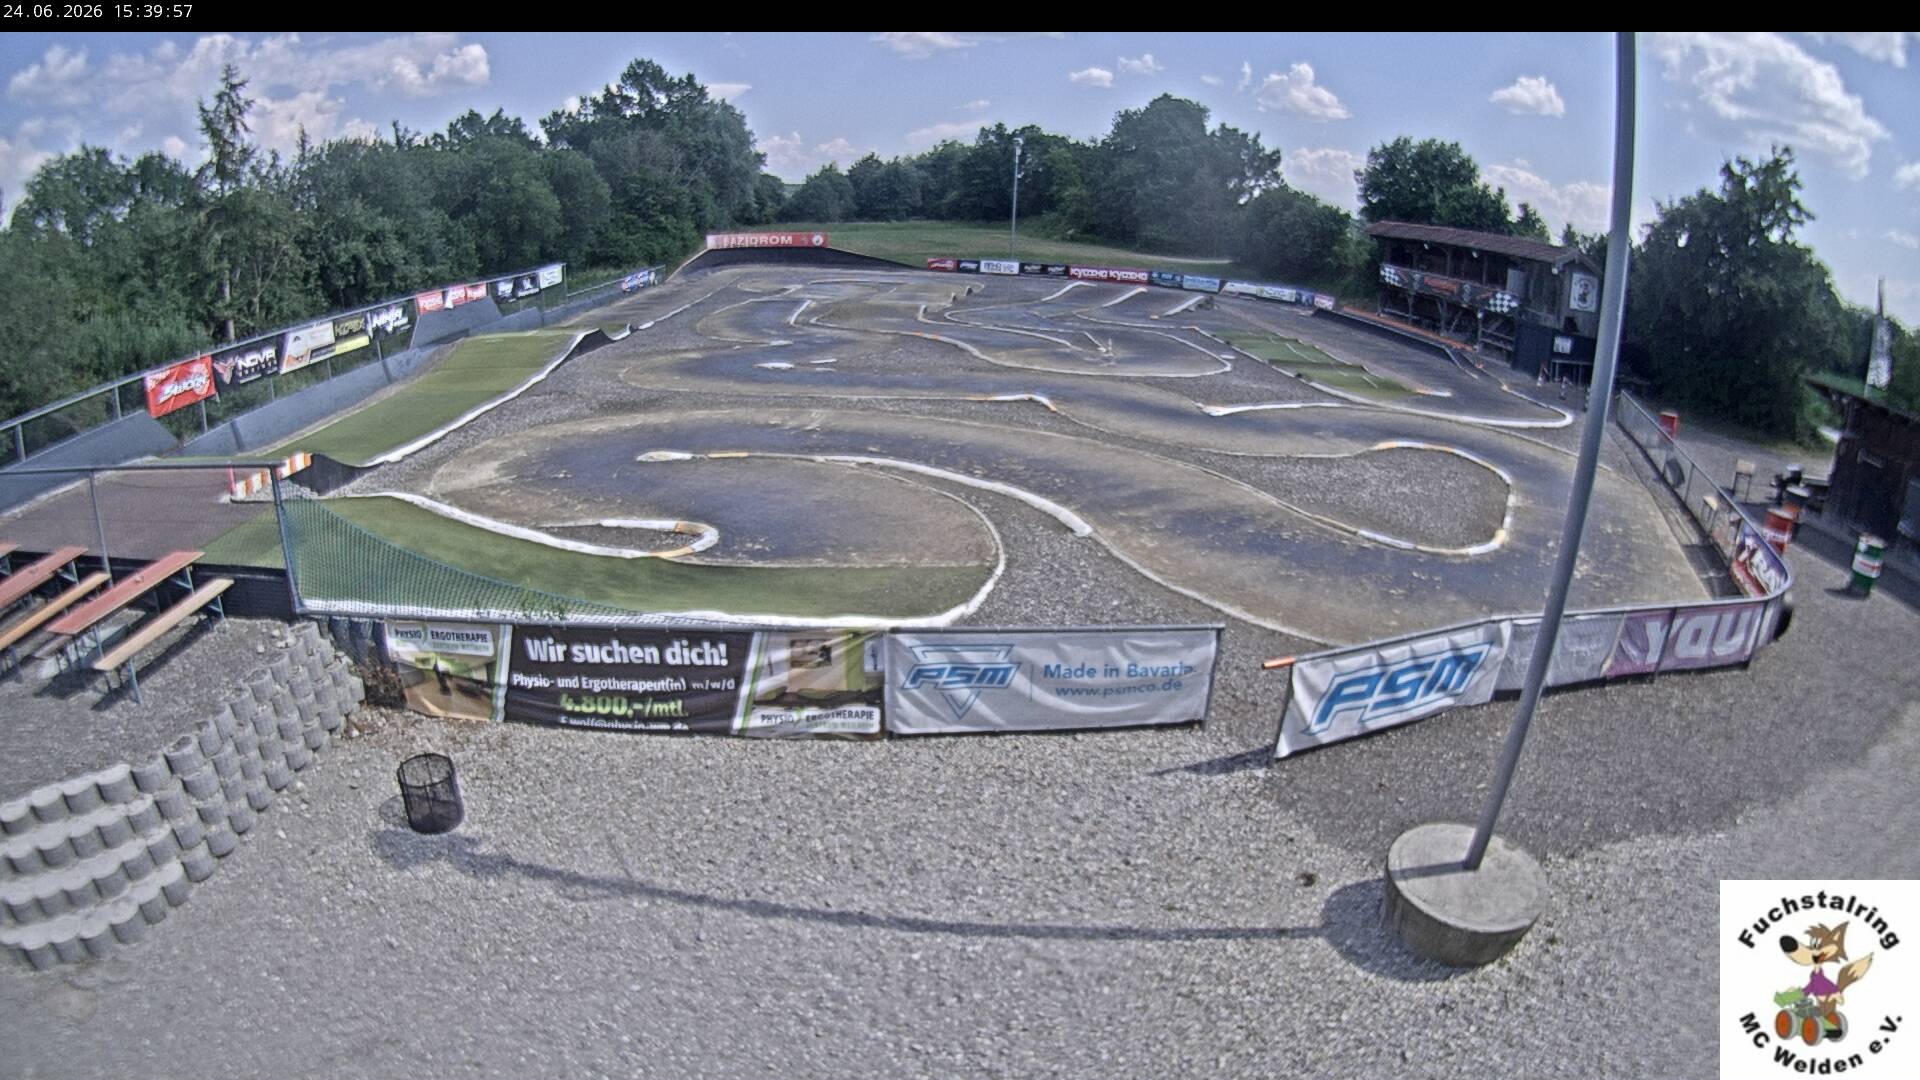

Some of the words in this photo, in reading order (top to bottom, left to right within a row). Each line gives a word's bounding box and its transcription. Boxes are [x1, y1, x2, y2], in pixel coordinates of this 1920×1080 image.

[430, 630, 488, 643] ERGOTHERAPIE
[525, 637, 567, 662] Wir
[571, 638, 660, 665] suchen
[665, 639, 729, 667] dich!
[1043, 662, 1097, 679] Made
[1104, 664, 1119, 679] in
[512, 673, 554, 689] Physio-
[556, 675, 579, 689] und
[581, 676, 687, 694] Ergotherapeut(in)
[691, 678, 736, 691] m/w/d
[1056, 679, 1183, 697] www.psmco.de
